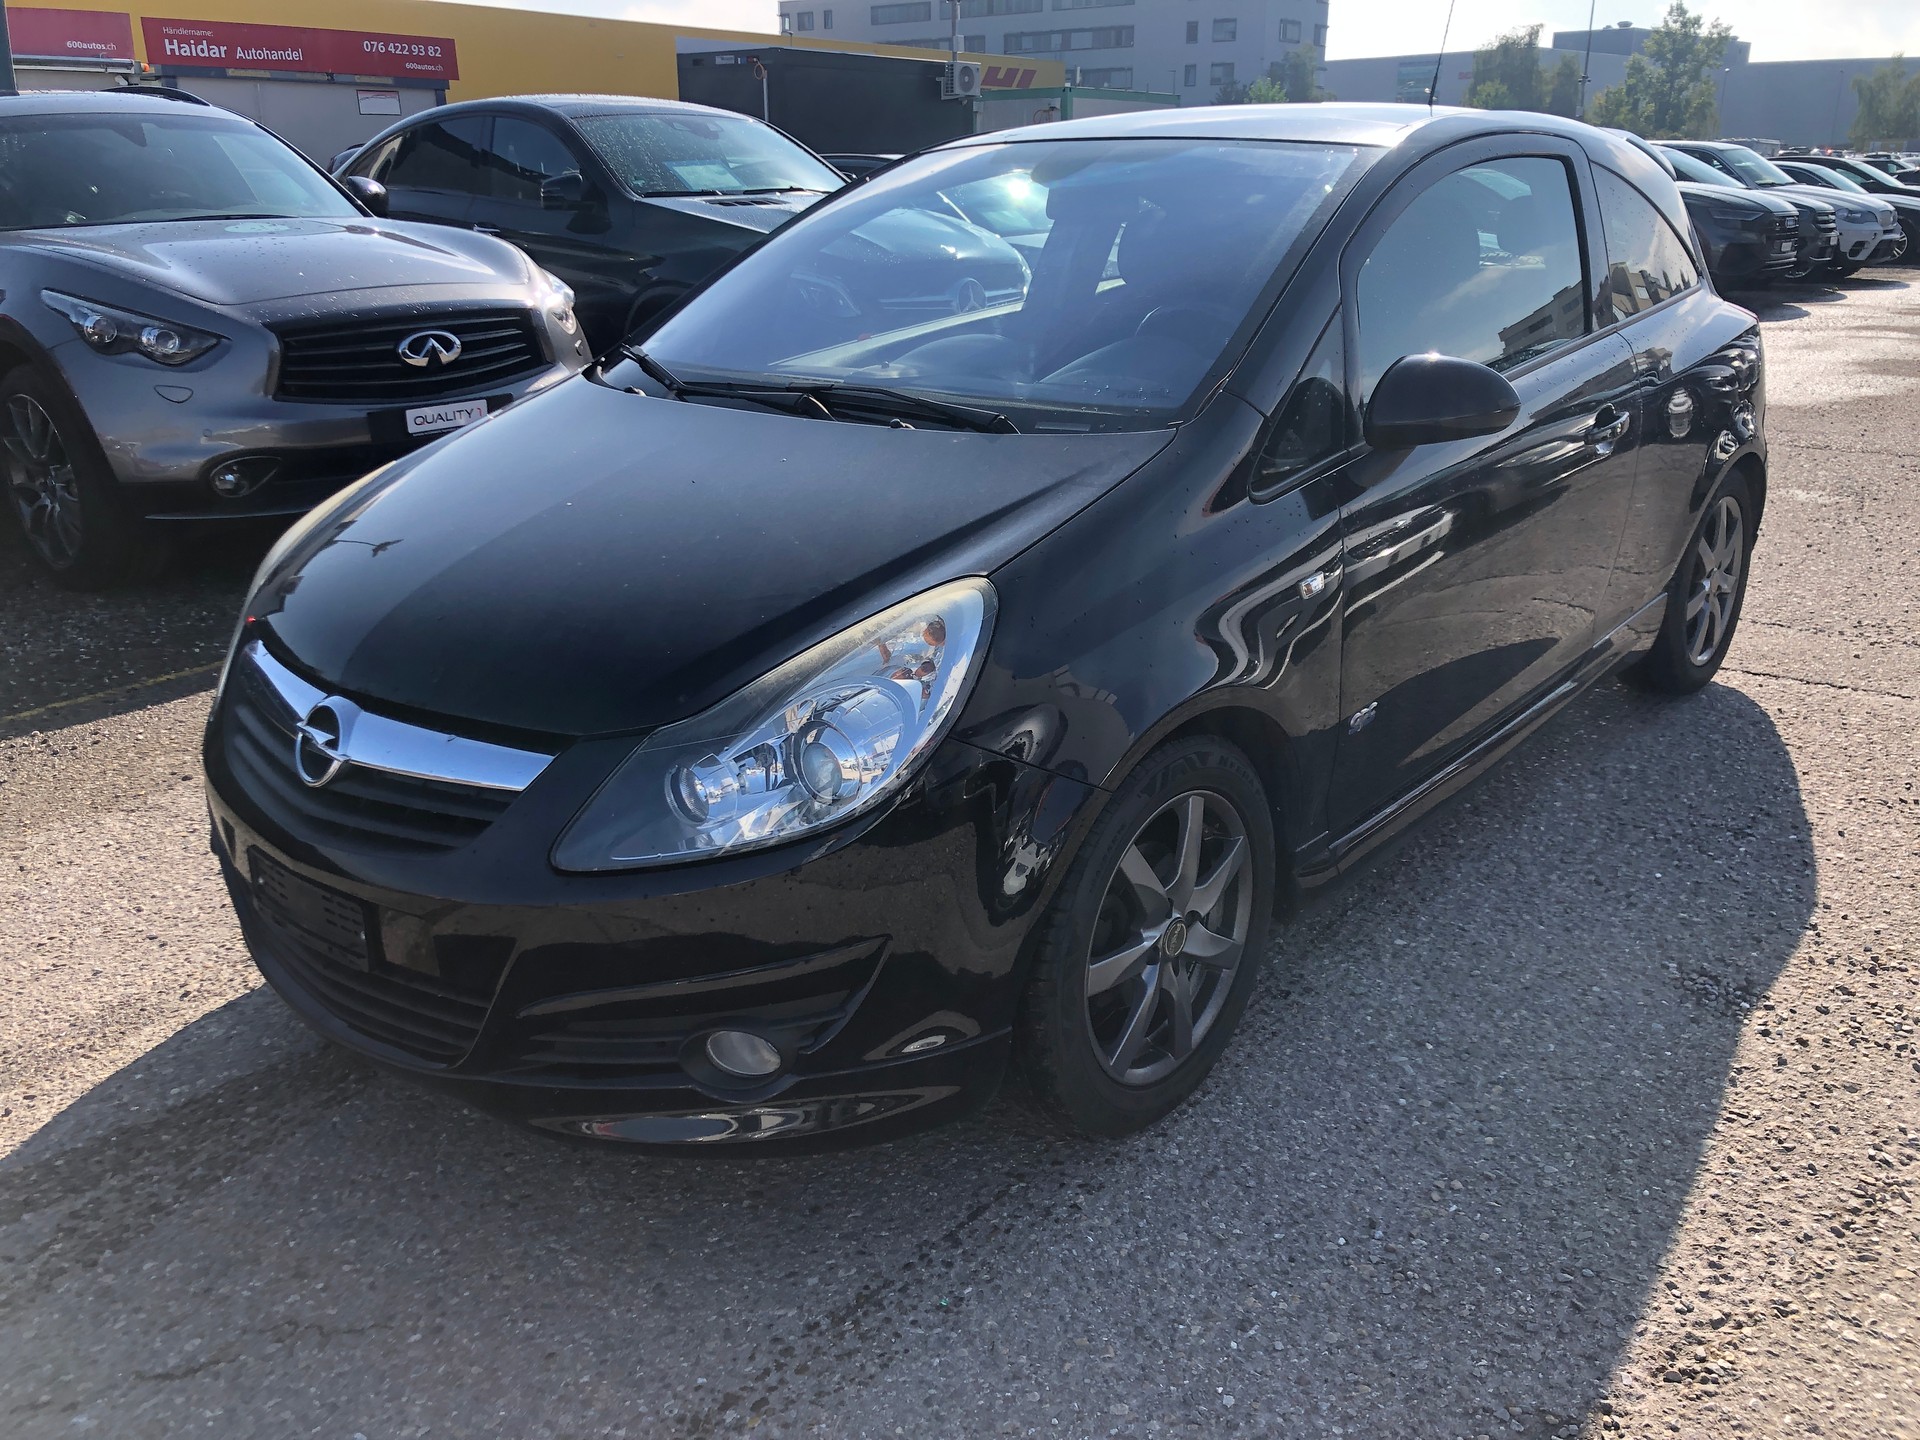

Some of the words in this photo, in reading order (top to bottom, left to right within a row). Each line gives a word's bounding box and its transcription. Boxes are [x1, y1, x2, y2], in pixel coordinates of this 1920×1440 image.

[162, 26, 214, 37] Händlername:
[66, 40, 117, 51] 600autos.ch
[164, 38, 227, 58] Haidar
[236, 46, 303, 61] Autohandel
[363, 40, 386, 53] 076
[387, 42, 410, 55] 422
[411, 44, 426, 56] 93
[427, 45, 442, 57] 82
[405, 62, 444, 72] 600autos.ch
[413, 408, 474, 426] QUALITY
